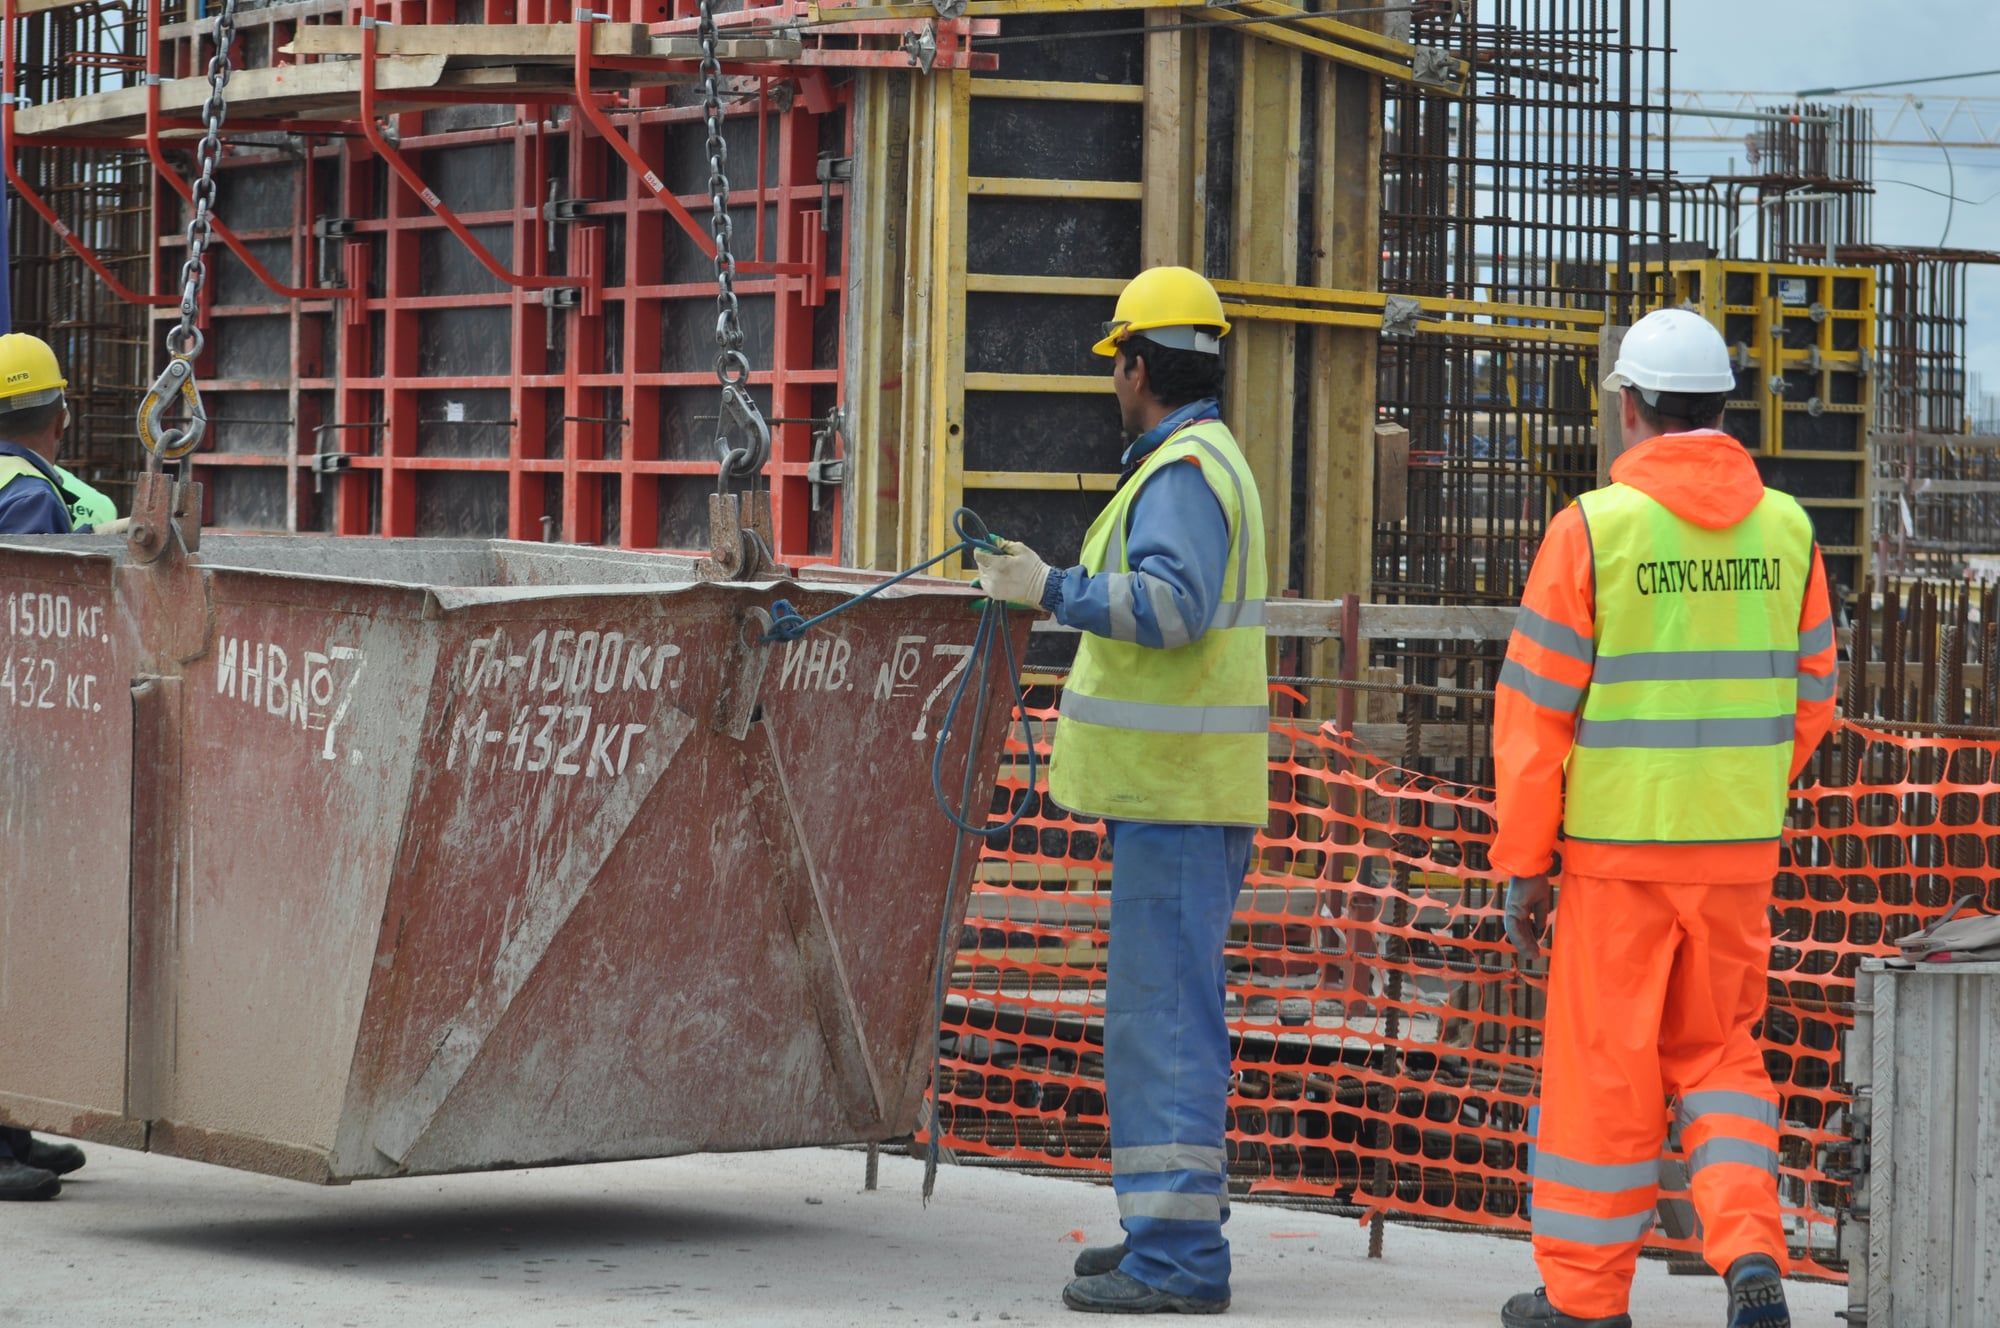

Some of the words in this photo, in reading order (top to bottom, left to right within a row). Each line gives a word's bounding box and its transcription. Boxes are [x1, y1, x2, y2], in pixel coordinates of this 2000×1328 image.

[1636, 560, 1698, 595] СТАТУС
[1701, 558, 1781, 591] КАПИТАЛ
[8, 592, 71, 638] 1500
[0, 655, 56, 709] 432
